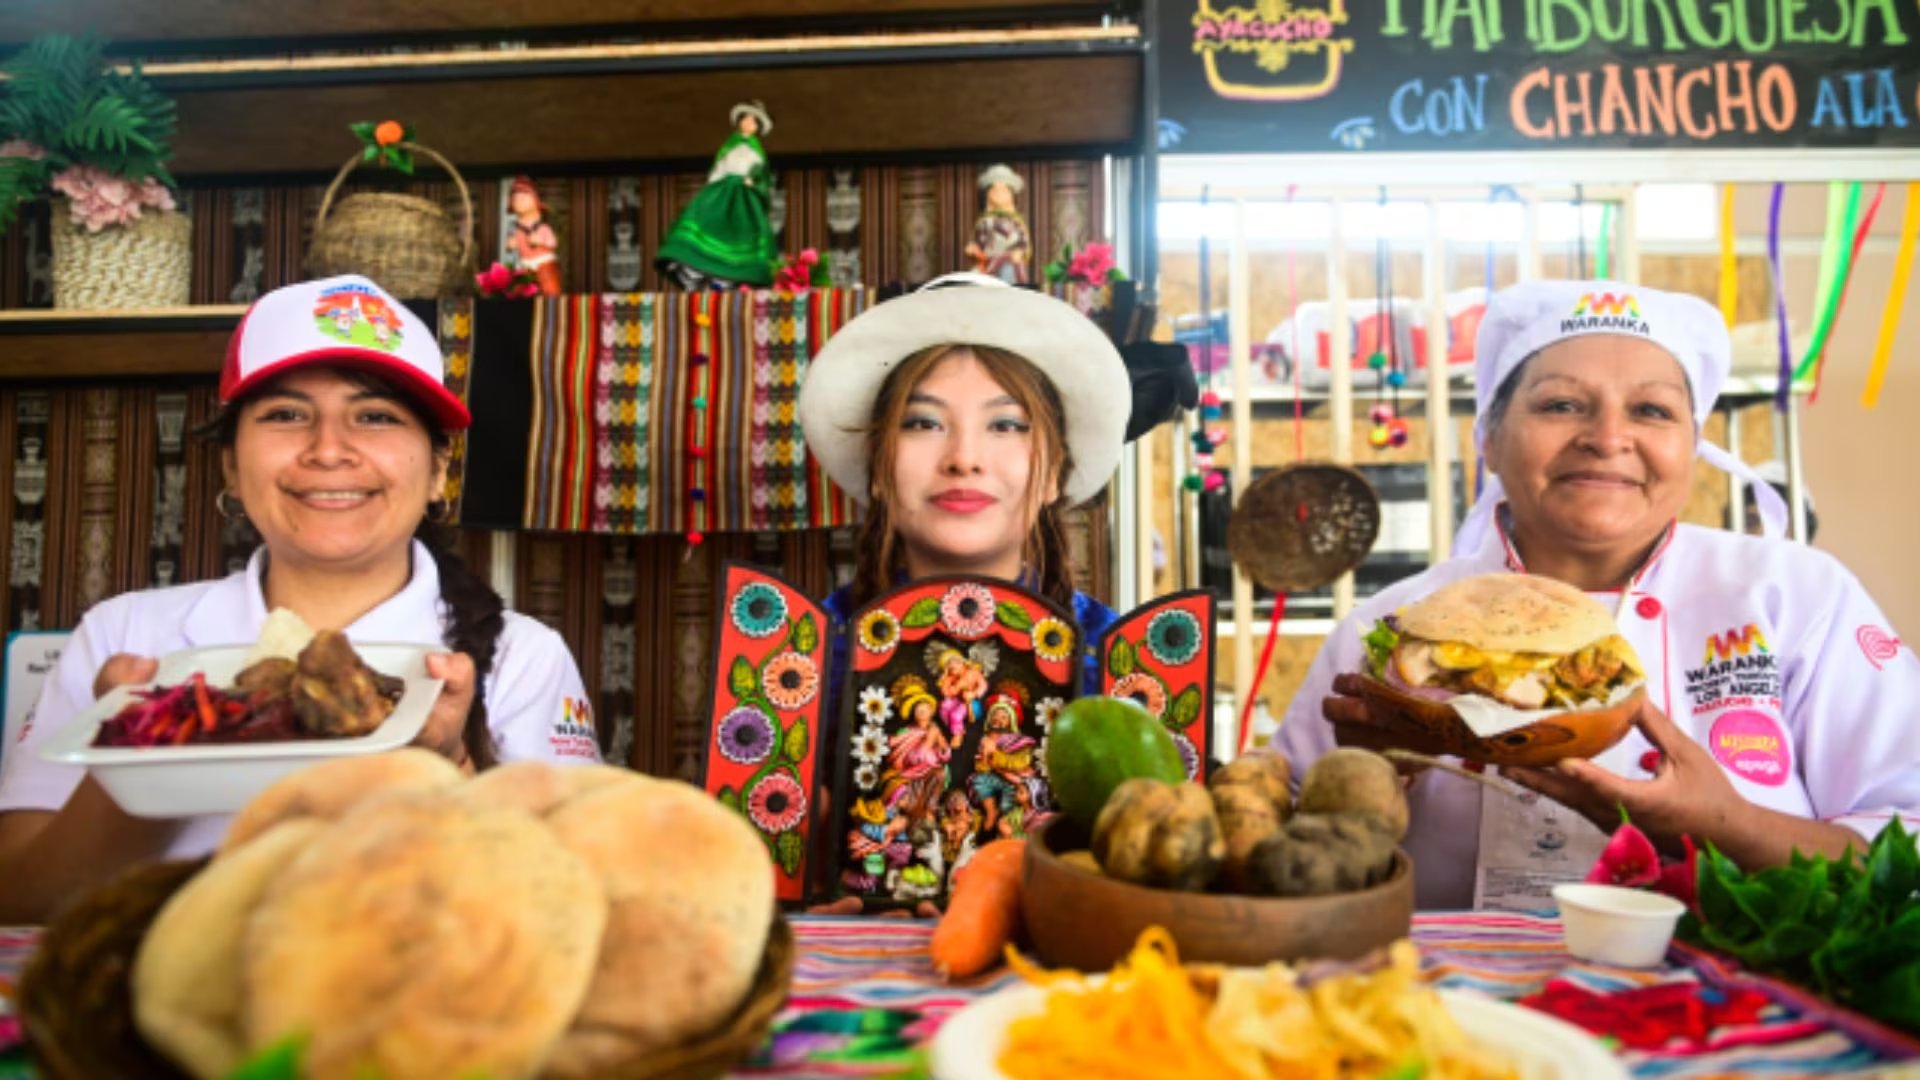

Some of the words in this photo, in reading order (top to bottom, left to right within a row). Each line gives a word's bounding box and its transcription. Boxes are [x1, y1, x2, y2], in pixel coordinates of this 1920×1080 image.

[1194, 17, 1334, 41] AYACUCHO
[1510, 60, 1797, 140] CHANCHO
[1560, 315, 1650, 334] WARANKA
[1686, 655, 1776, 682] WARANK
